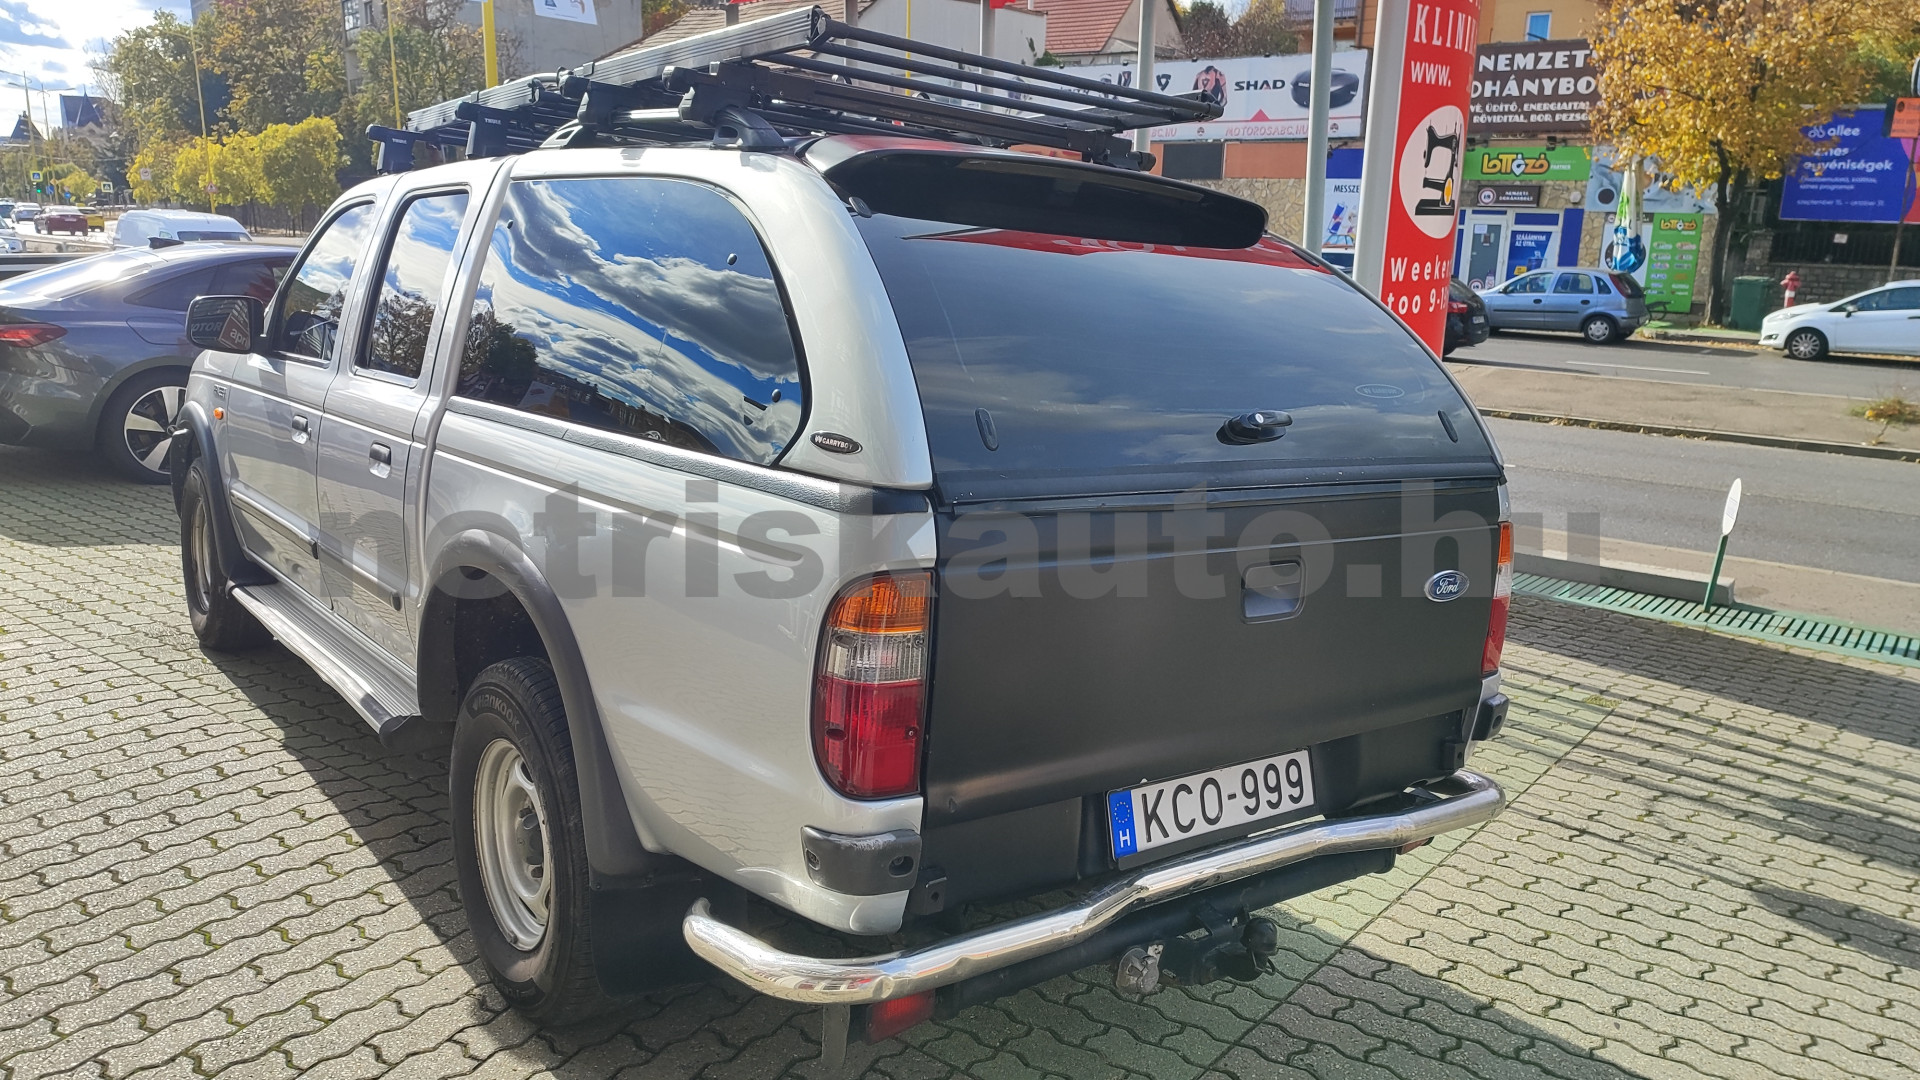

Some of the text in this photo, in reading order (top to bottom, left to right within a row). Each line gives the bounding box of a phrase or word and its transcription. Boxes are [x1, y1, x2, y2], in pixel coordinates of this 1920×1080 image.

[1234, 79, 1286, 91] SHAD
[1388, 293, 1421, 315] too
[1436, 577, 1460, 595] Ford
[1141, 759, 1304, 843] KCO-999
[1119, 829, 1131, 848] H
